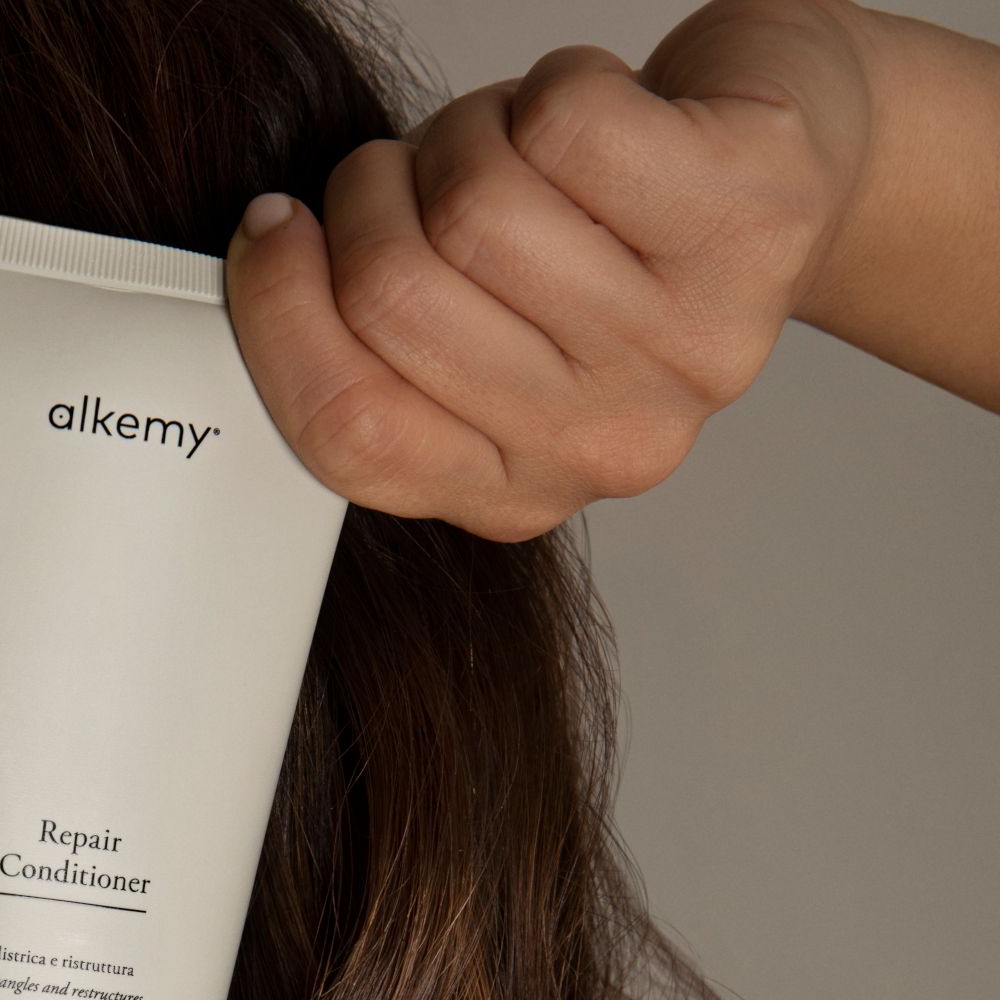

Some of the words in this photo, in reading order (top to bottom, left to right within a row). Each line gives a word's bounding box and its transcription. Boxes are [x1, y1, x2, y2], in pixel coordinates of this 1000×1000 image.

[38, 819, 123, 855] Repair
[0, 853, 151, 894] Conditioner
[50, 956, 58, 966] e
[62, 955, 135, 977] ristruttura
[41, 981, 71, 996] and
